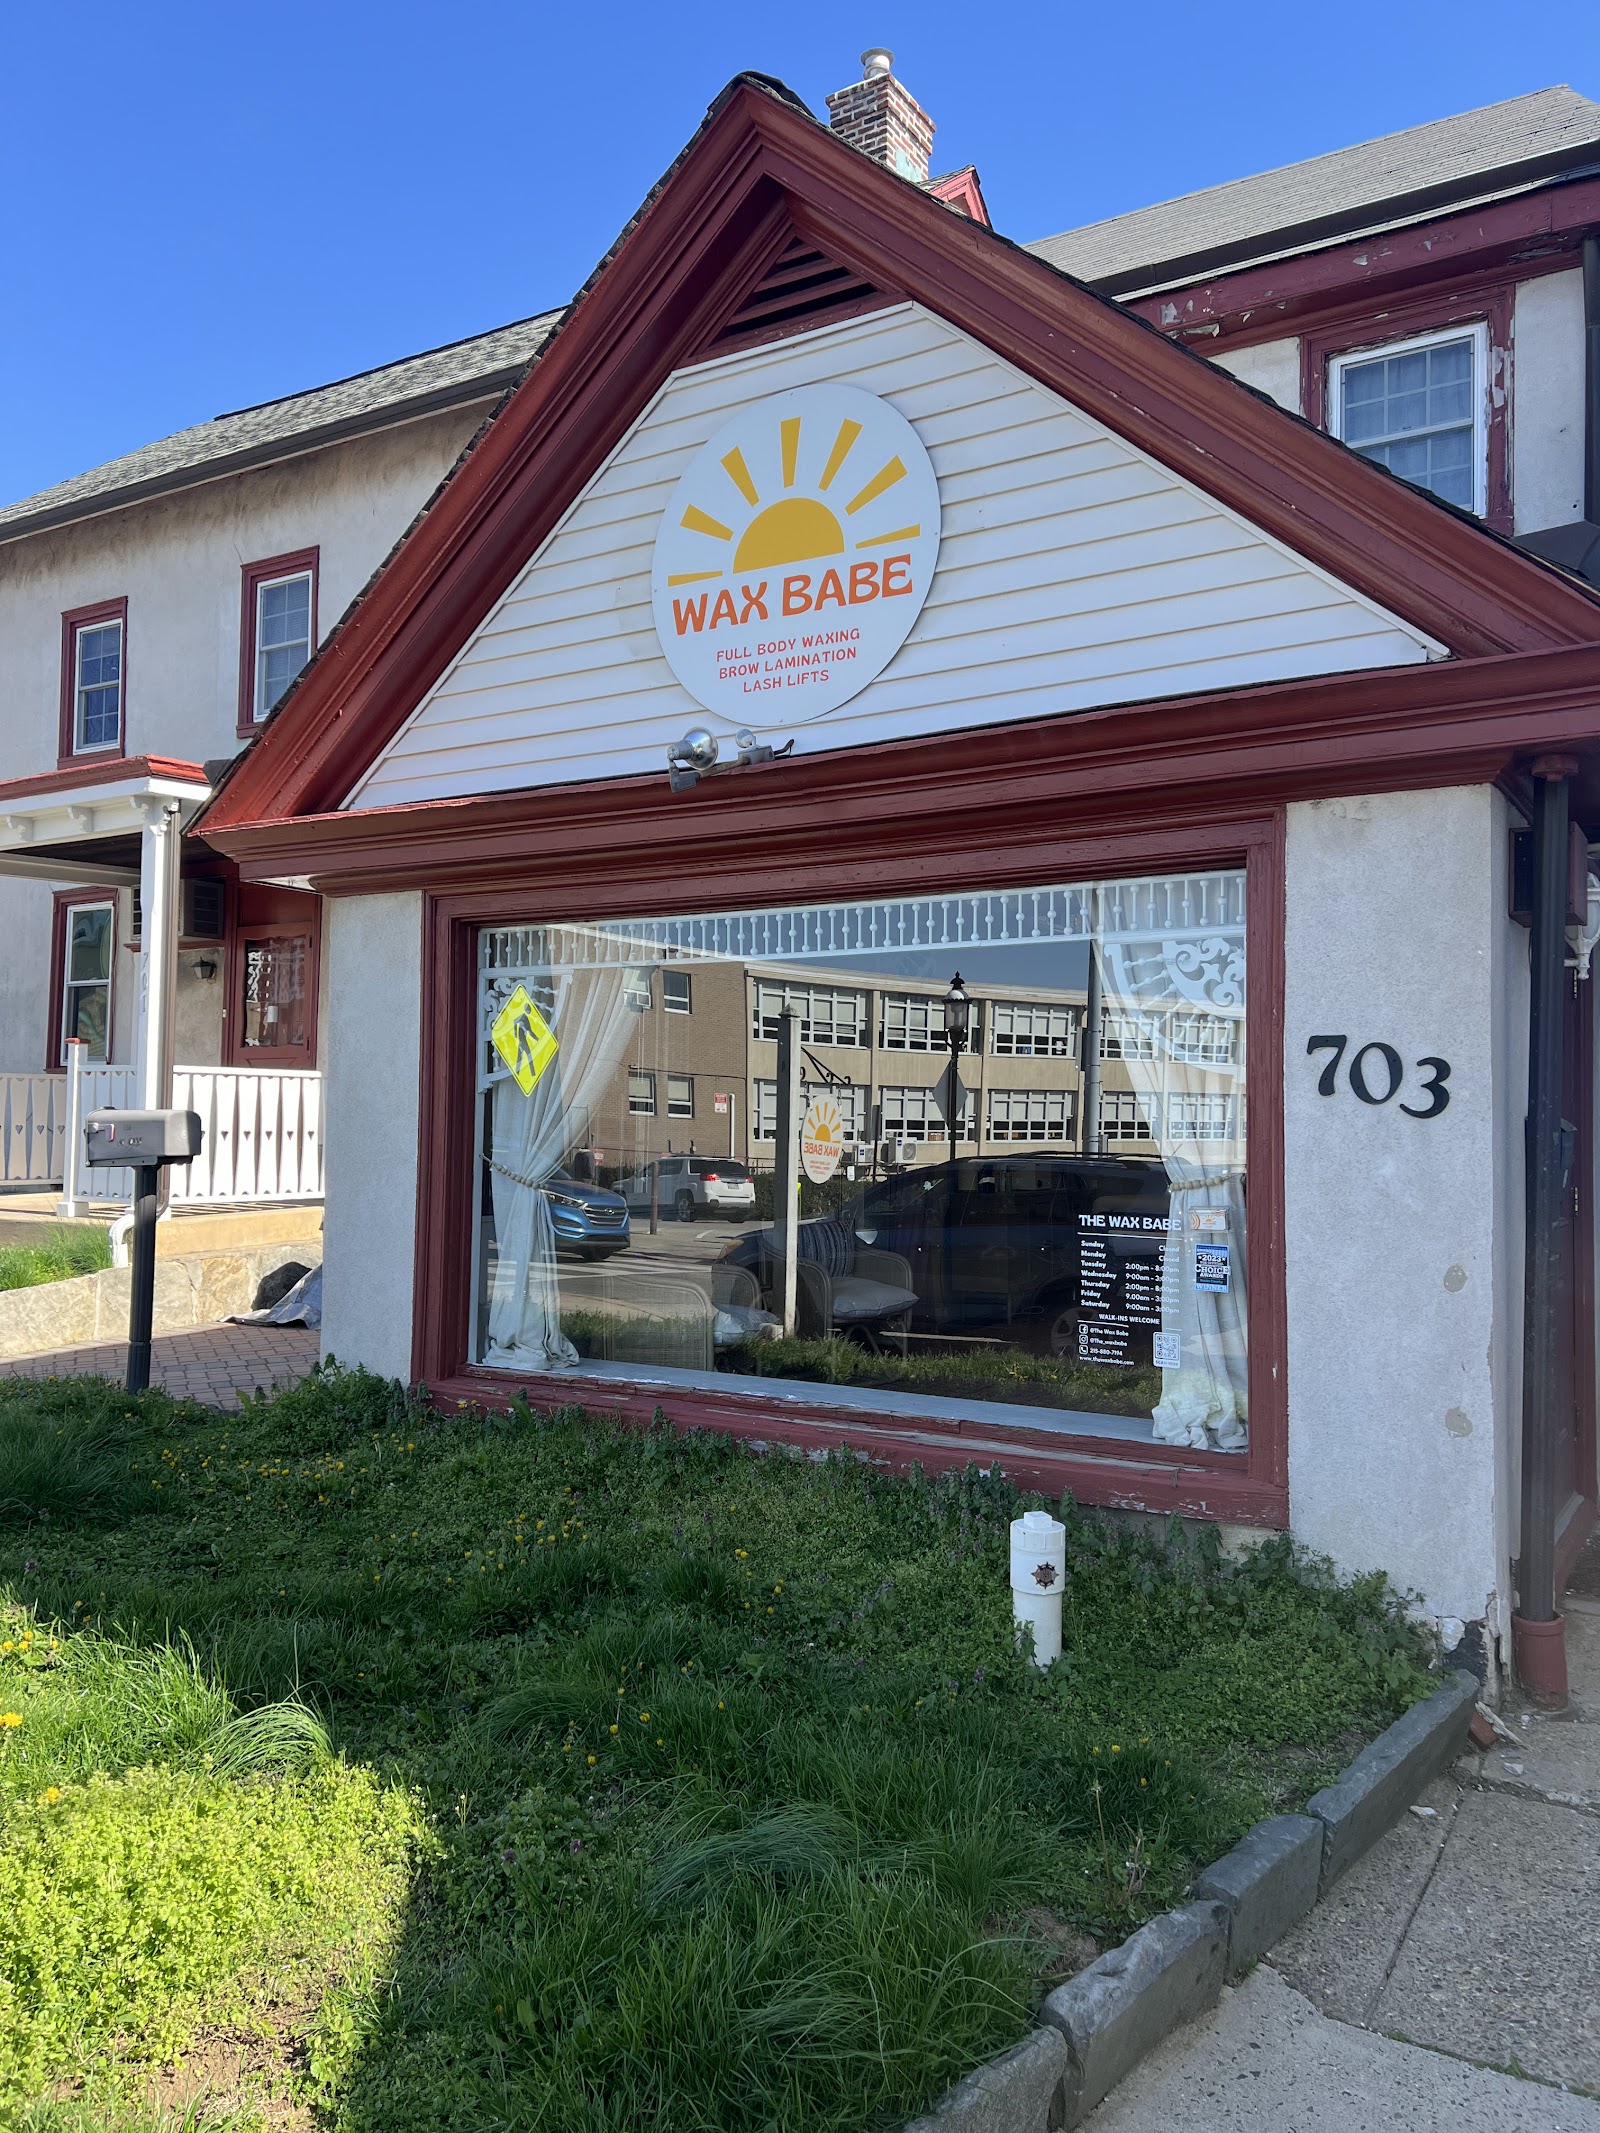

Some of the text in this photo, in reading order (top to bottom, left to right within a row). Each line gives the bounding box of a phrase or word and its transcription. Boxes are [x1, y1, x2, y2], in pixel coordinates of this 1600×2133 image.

[672, 553, 913, 636] WAX BABE
[716, 628, 860, 663] FULL BODY WAXING
[719, 646, 857, 680] BROW LAMINATION
[743, 670, 830, 693] LASH LIFTS
[1306, 1034, 1452, 1119] 703
[1078, 1214, 1182, 1231] THE WAX BABE
[1080, 1240, 1105, 1249] Sunday
[1080, 1250, 1106, 1259] Monday
[1080, 1260, 1106, 1269] Tuesday
[1125, 1263, 1150, 1272] 2:00pm
[1195, 1264, 1230, 1275] CHOICE
[1080, 1270, 1117, 1280] Wednesday
[1080, 1280, 1110, 1289] Thursday
[1125, 1283, 1150, 1292] 2:00pm
[1155, 1285, 1179, 1294] 8:00pm
[1080, 1290, 1101, 1299] Friday
[1155, 1296, 1179, 1304] 3:00pm
[1080, 1300, 1110, 1309] Saturday
[1126, 1303, 1150, 1311] 9:00am
[1155, 1306, 1179, 1314] 3:00pm
[1099, 1314, 1160, 1324] WALK-INS WELCOME
